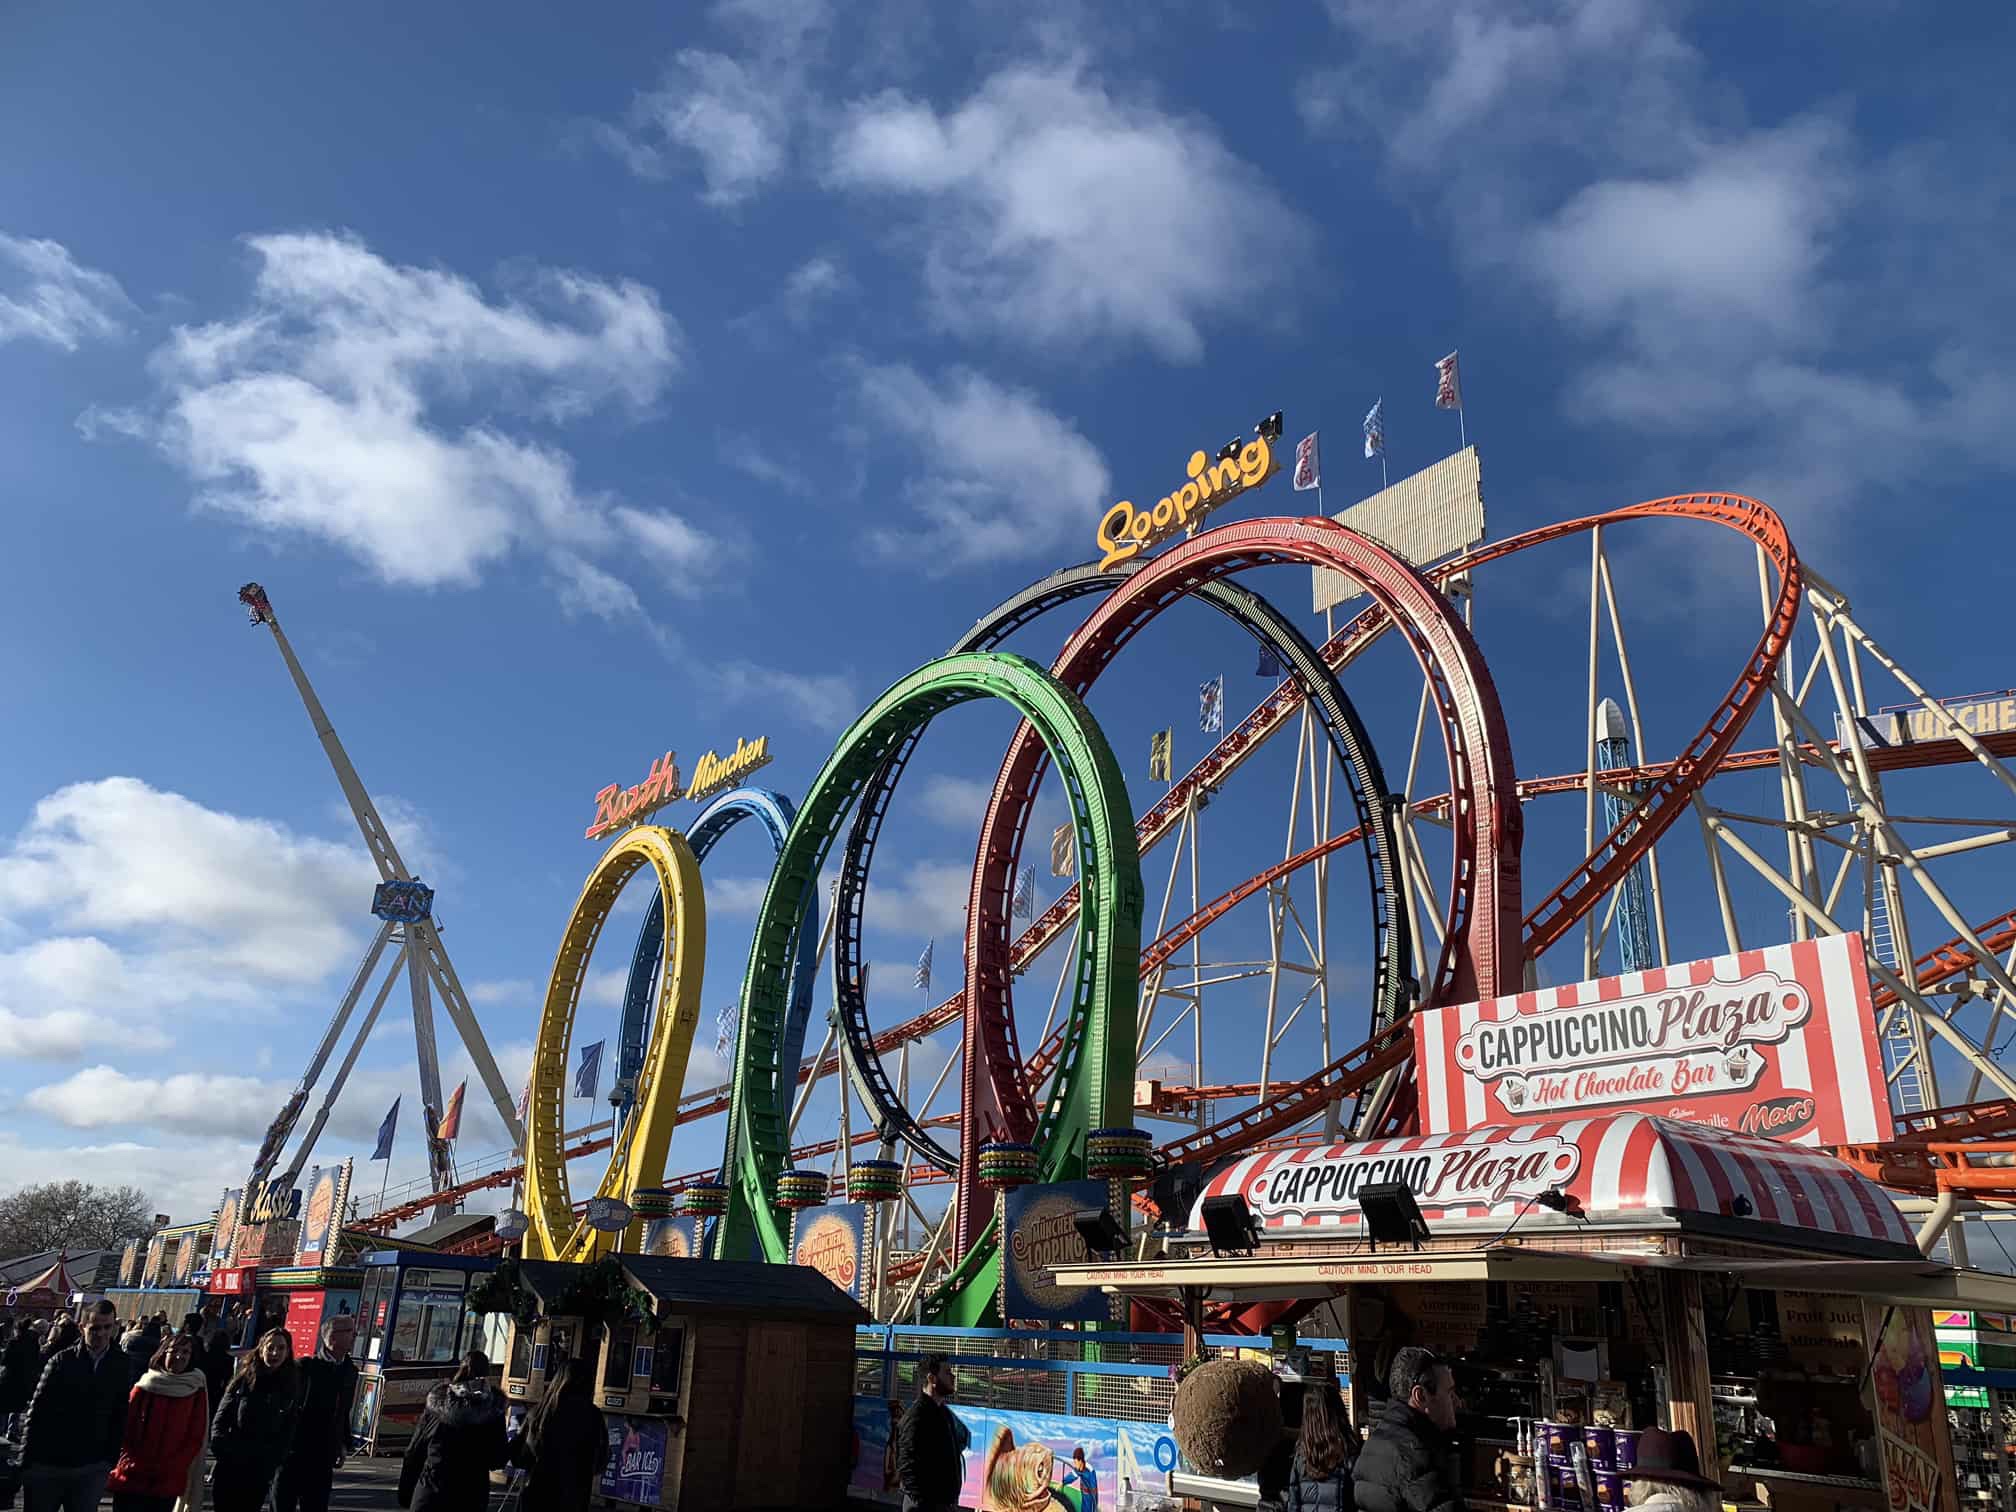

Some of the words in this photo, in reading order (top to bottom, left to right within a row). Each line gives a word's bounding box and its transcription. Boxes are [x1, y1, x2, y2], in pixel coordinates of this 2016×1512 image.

[1097, 434, 1271, 572] Looping
[1479, 1004, 1649, 1069] CAPPUCCINO
[1647, 986, 1776, 1048] Plaza
[1533, 1076, 1567, 1105] Hot
[1573, 1066, 1664, 1101] Chocolate
[1670, 1058, 1715, 1094] Bar
[1740, 1097, 1816, 1134] Mars
[1268, 1155, 1431, 1205] CAPPUCCINO
[1424, 1146, 1550, 1200] Plaza
[1357, 1264, 1378, 1275] MIND
[1382, 1264, 1405, 1274] YOUR
[1408, 1264, 1433, 1274] HEAD
